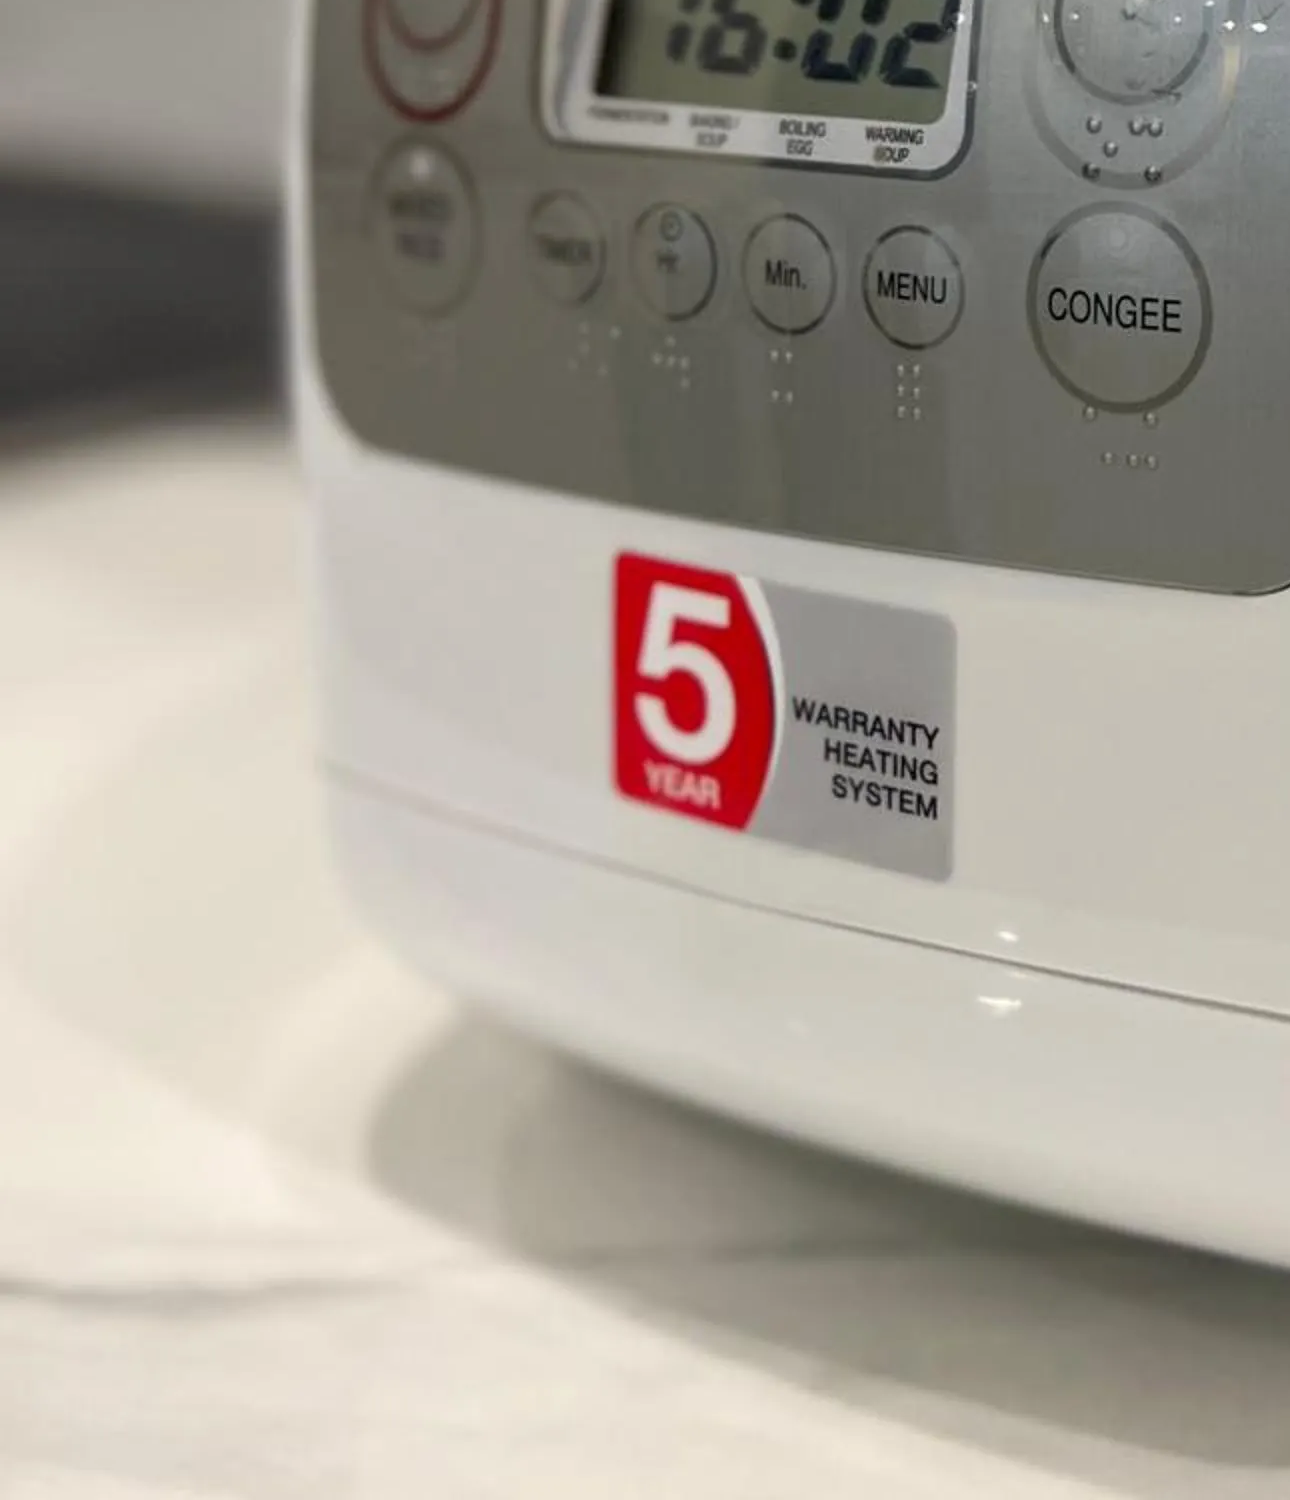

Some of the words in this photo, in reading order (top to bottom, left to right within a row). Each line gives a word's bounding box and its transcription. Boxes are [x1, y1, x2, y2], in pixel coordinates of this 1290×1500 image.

[778, 118, 827, 138] BOILING
[786, 138, 814, 157] EGG
[865, 126, 925, 146] WARMING
[765, 259, 807, 290] Min.
[876, 270, 947, 304] MENU
[1048, 287, 1182, 333] CONGEE
[633, 580, 738, 766] 5
[792, 696, 940, 750] WARRANTY
[824, 738, 938, 786] HEATING
[643, 761, 722, 810] YEAR
[832, 775, 938, 820] SYSTEM
